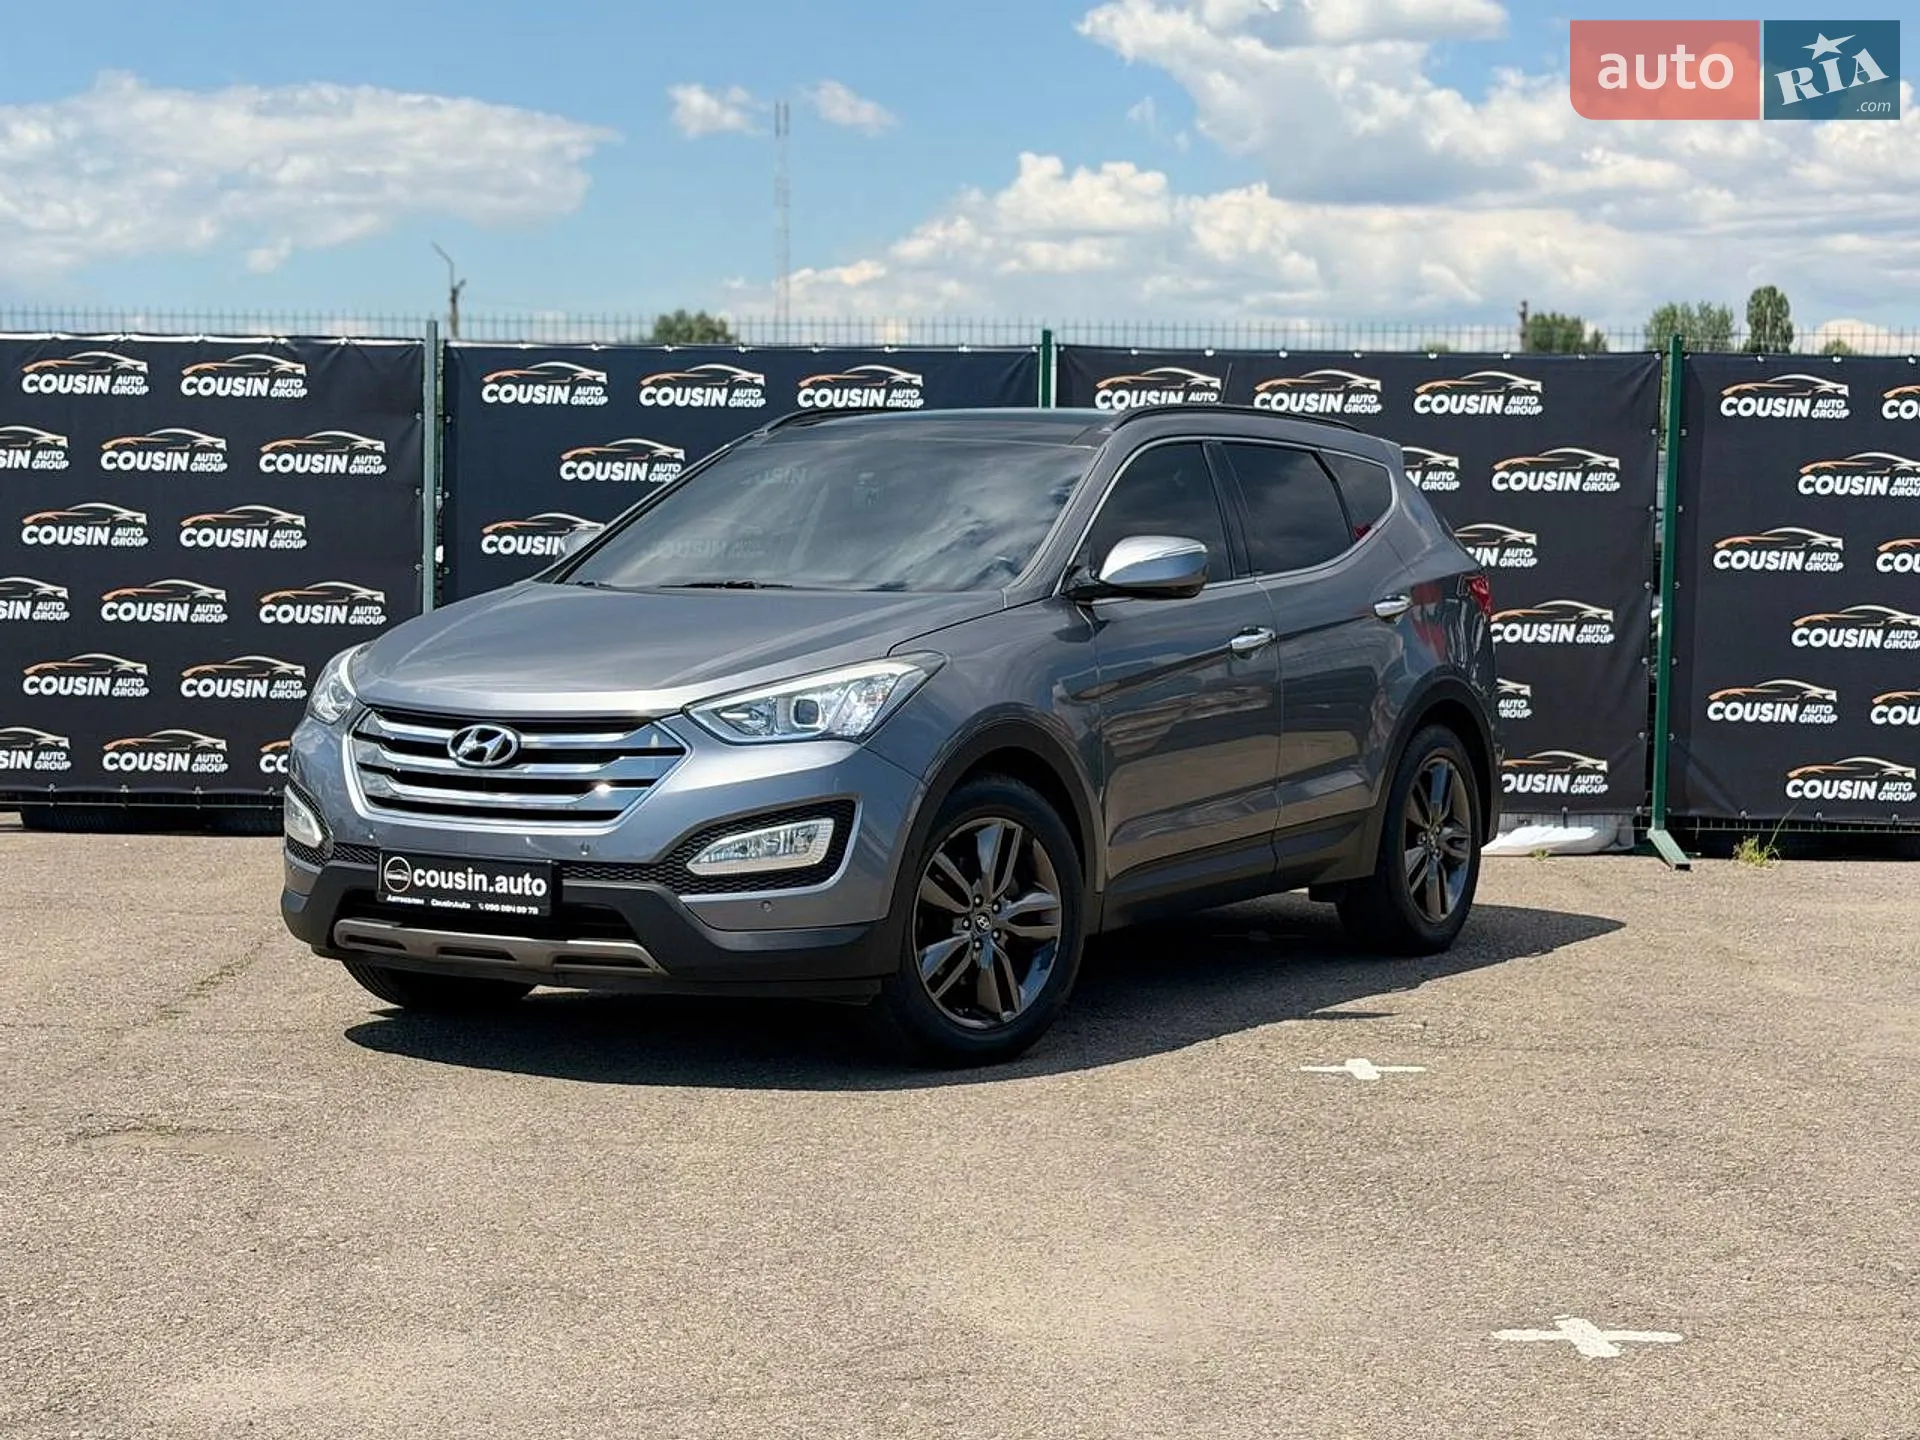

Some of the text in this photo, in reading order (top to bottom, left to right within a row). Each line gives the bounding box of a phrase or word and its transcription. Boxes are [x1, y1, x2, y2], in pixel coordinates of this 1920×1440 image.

[22, 374, 144, 394] COUSIN AUTO
[111, 384, 148, 395] GROUP
[181, 377, 303, 397] COUSIN AUTO
[270, 387, 307, 398] GROUP
[482, 384, 604, 404] COUSIN AUTO
[640, 387, 762, 407] COUSIN AUTO
[797, 388, 919, 408] COUSIN AUTO
[1187, 391, 1218, 402] AUTO
[571, 394, 608, 405] GROUP
[729, 397, 766, 408] GROUP
[886, 398, 923, 409] GROUP
[1253, 392, 1378, 412] COUSIN AUTO
[1414, 394, 1538, 414] COUSIN AUTO
[1344, 402, 1382, 413] GROUP
[1504, 404, 1542, 415] GROUP
[1721, 397, 1845, 417] COUSIN AUTO
[1811, 407, 1849, 418] GROUP
[36, 450, 65, 459] AUTO
[31, 460, 69, 470] GROUP
[101, 451, 223, 471] COUSIN AUTO
[190, 461, 227, 472] GROUP
[260, 453, 382, 473] COUSIN AUTO
[349, 463, 386, 474] GROUP
[560, 461, 682, 481] COUSIN AUTO
[649, 472, 677, 482] GRO
[1425, 470, 1456, 482] AUTO
[1492, 471, 1616, 491] COUSIN AUTO
[1421, 480, 1461, 491] GROUP
[1582, 481, 1620, 492] GROUP
[1798, 475, 1890, 496] COUSIN
[1889, 486, 1920, 497] GROU
[22, 525, 144, 545] COUSIN AUTO
[111, 535, 148, 546] GROUP
[180, 528, 302, 548] COUSIN AUTO
[269, 538, 306, 549] GROUP
[1503, 547, 1533, 558] AUTO
[1499, 557, 1538, 567] GROUP
[1714, 550, 1838, 570] COUSIN AUTO
[1804, 560, 1842, 571] GROUP
[36, 601, 65, 611] AUTO
[32, 610, 70, 621] GROUP
[101, 602, 223, 622] COUSIN AUTO
[190, 612, 227, 623] GROUP
[260, 604, 382, 624] COUSIN AUTO
[349, 614, 386, 625] GROUP
[1580, 625, 1610, 634] AUTO
[1576, 633, 1614, 644] GROUP
[1791, 627, 1919, 648] COUSIN AUTO
[23, 676, 145, 696] COUSIN AUTO
[112, 686, 149, 697] GROUP
[181, 678, 303, 698] COUSIN AUTO
[270, 688, 307, 699] GROUP
[1498, 699, 1527, 709] AUTO
[1708, 702, 1832, 722] COUSIN AUTO
[1798, 712, 1836, 723] GROUP
[37, 751, 66, 761] AUTO
[34, 760, 71, 771] GROUP
[102, 752, 224, 772] COUSIN AUTO
[191, 762, 228, 773] GROUP
[1501, 774, 1605, 793] OUSIN AUTO
[1571, 783, 1609, 794] GROUP
[1787, 780, 1911, 800] COUSIN AUTO
[1877, 790, 1915, 801] GROUP
[413, 867, 547, 897] cousin.auto
